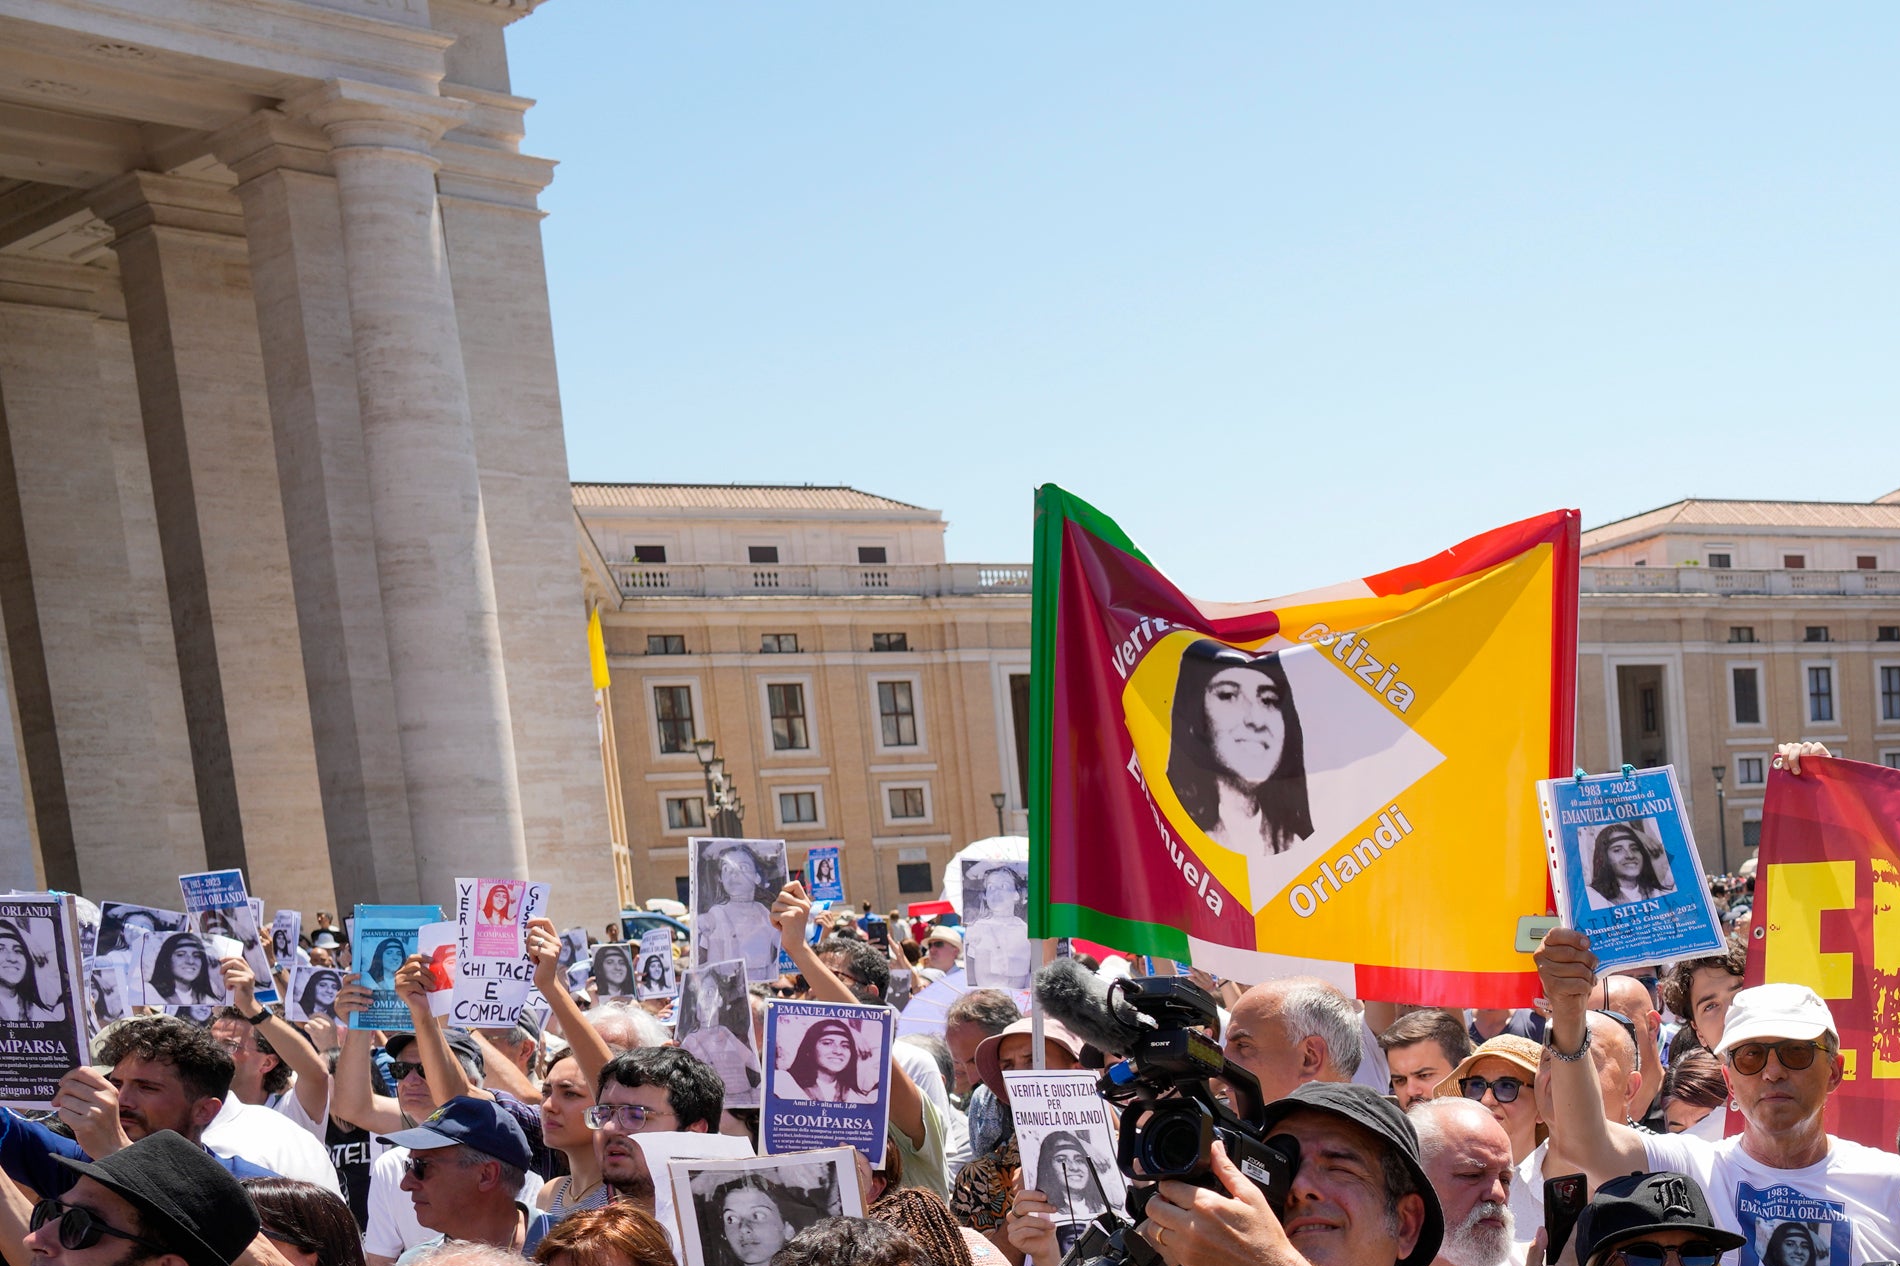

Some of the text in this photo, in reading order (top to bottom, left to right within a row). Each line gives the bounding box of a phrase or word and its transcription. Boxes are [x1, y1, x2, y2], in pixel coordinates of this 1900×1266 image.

[1579, 781, 1637, 797] 1983 2023
[1605, 794, 1646, 806] rapimento
[1646, 790, 1655, 798] di
[1561, 798, 1673, 825] EMANUELA ORLANDI
[1289, 804, 1414, 918] Orlandi
[208, 891, 246, 904] ORLANDI
[1, 905, 53, 918] ORLANDI
[1613, 900, 1660, 919] SIT-IN
[1585, 903, 1697, 936] Domenica 25 Giugno 2023
[462, 962, 535, 981] CHI TACE
[454, 1000, 524, 1022] COMPLIC
[777, 1005, 884, 1021] EMANUELA ORLANDI
[9, 1030, 16, 1040] È
[1, 1085, 55, 1096] giugno 1983
[1011, 1082, 1097, 1098] VERITÀ E GIUSTIZIA
[821, 1108, 827, 1116] È
[1047, 1099, 1062, 1110] PER
[773, 1114, 873, 1130] SCOMPARSA
[1015, 1109, 1104, 1126] EMANUELA ORLANDI
[1767, 1188, 1789, 1200] 1983
[1740, 1199, 1796, 1219] EMANUELA
